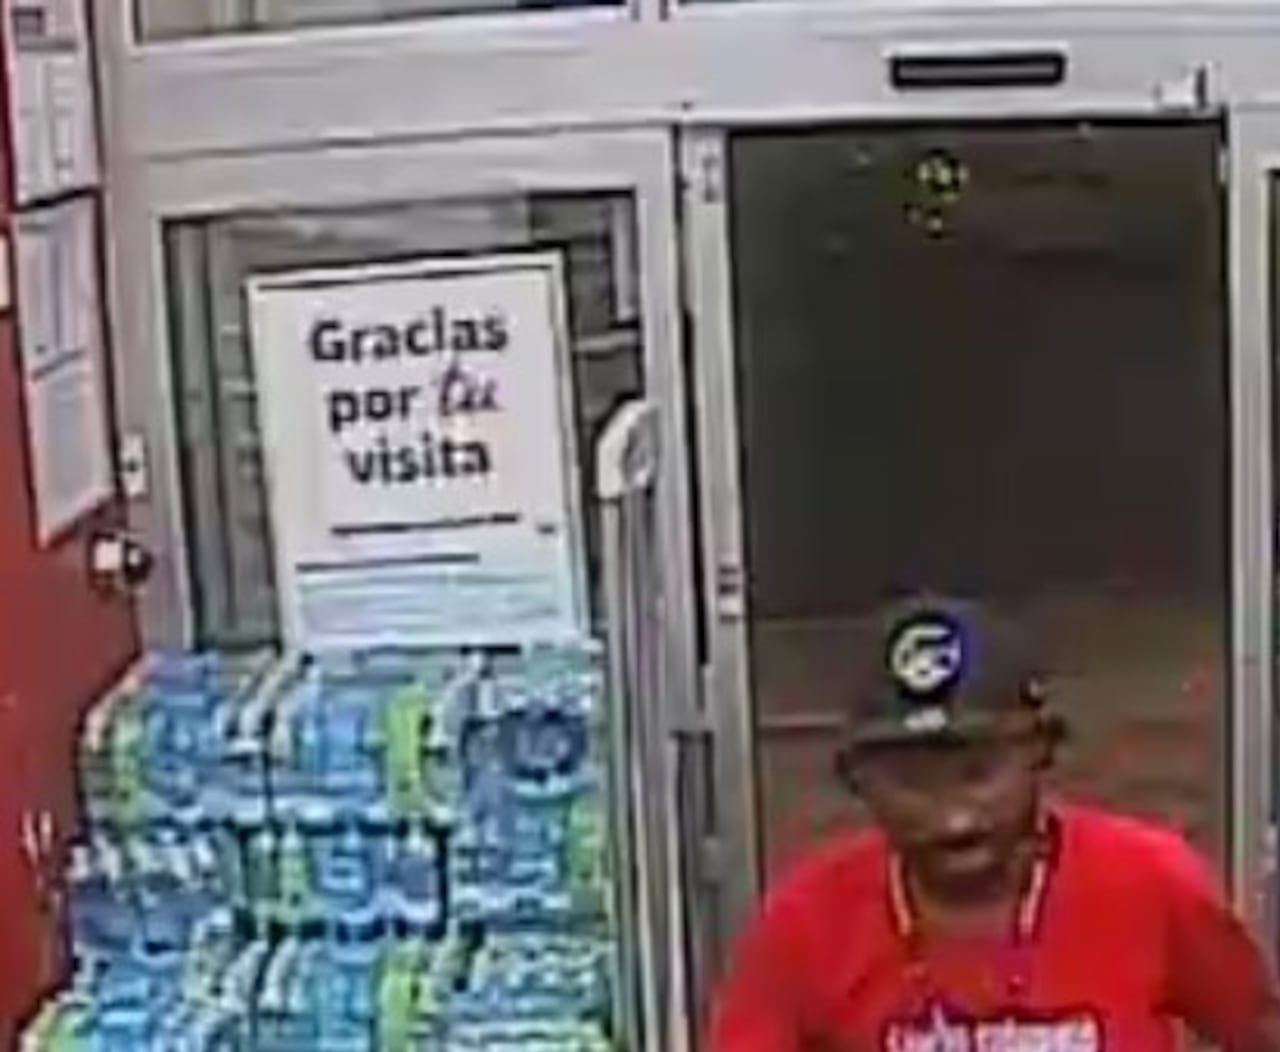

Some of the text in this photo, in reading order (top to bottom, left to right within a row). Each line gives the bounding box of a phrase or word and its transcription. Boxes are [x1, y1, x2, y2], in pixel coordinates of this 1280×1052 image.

[309, 306, 508, 362] Gracias
[329, 361, 501, 432] por tu
[347, 430, 490, 484] visita
